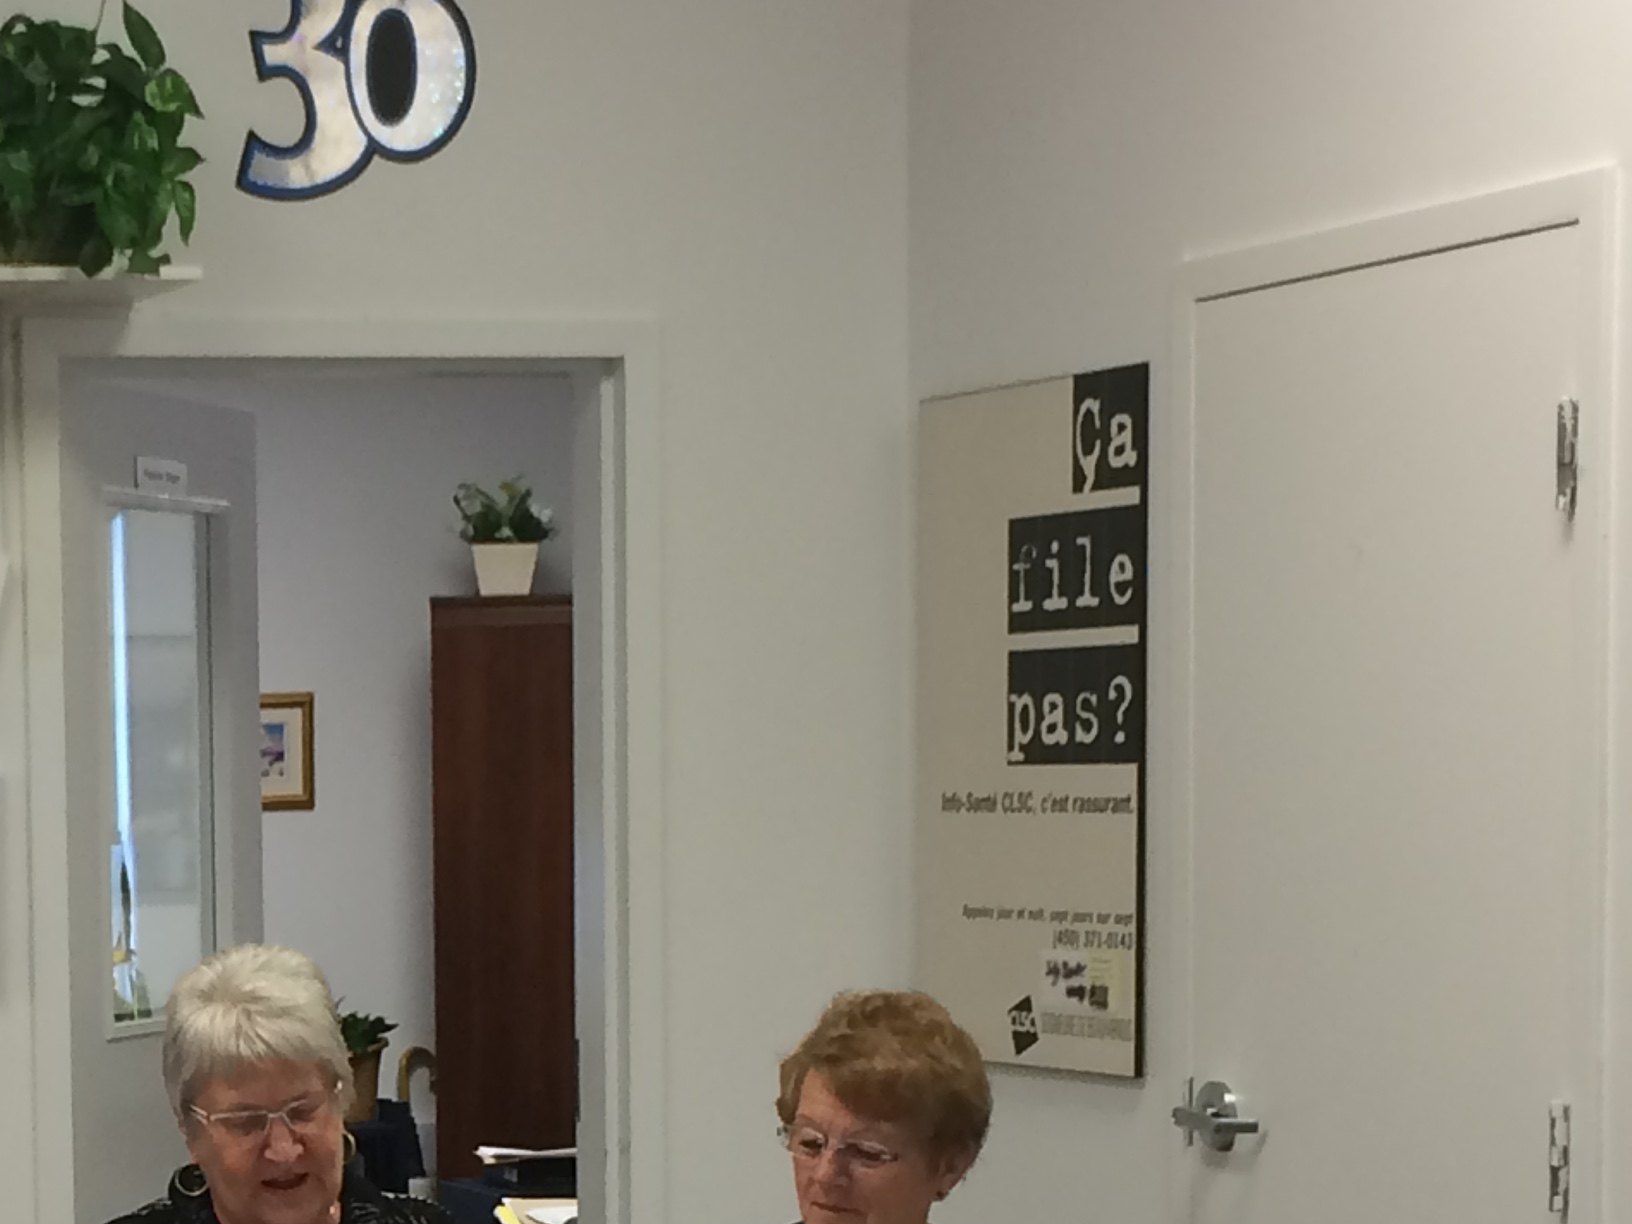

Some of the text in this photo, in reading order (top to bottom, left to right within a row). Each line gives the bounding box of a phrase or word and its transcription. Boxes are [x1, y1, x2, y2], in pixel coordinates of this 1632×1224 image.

[236, 0, 477, 201] 30
[1076, 397, 1137, 494] Ça
[1011, 535, 1134, 612] file
[1008, 675, 1133, 762] pas?
